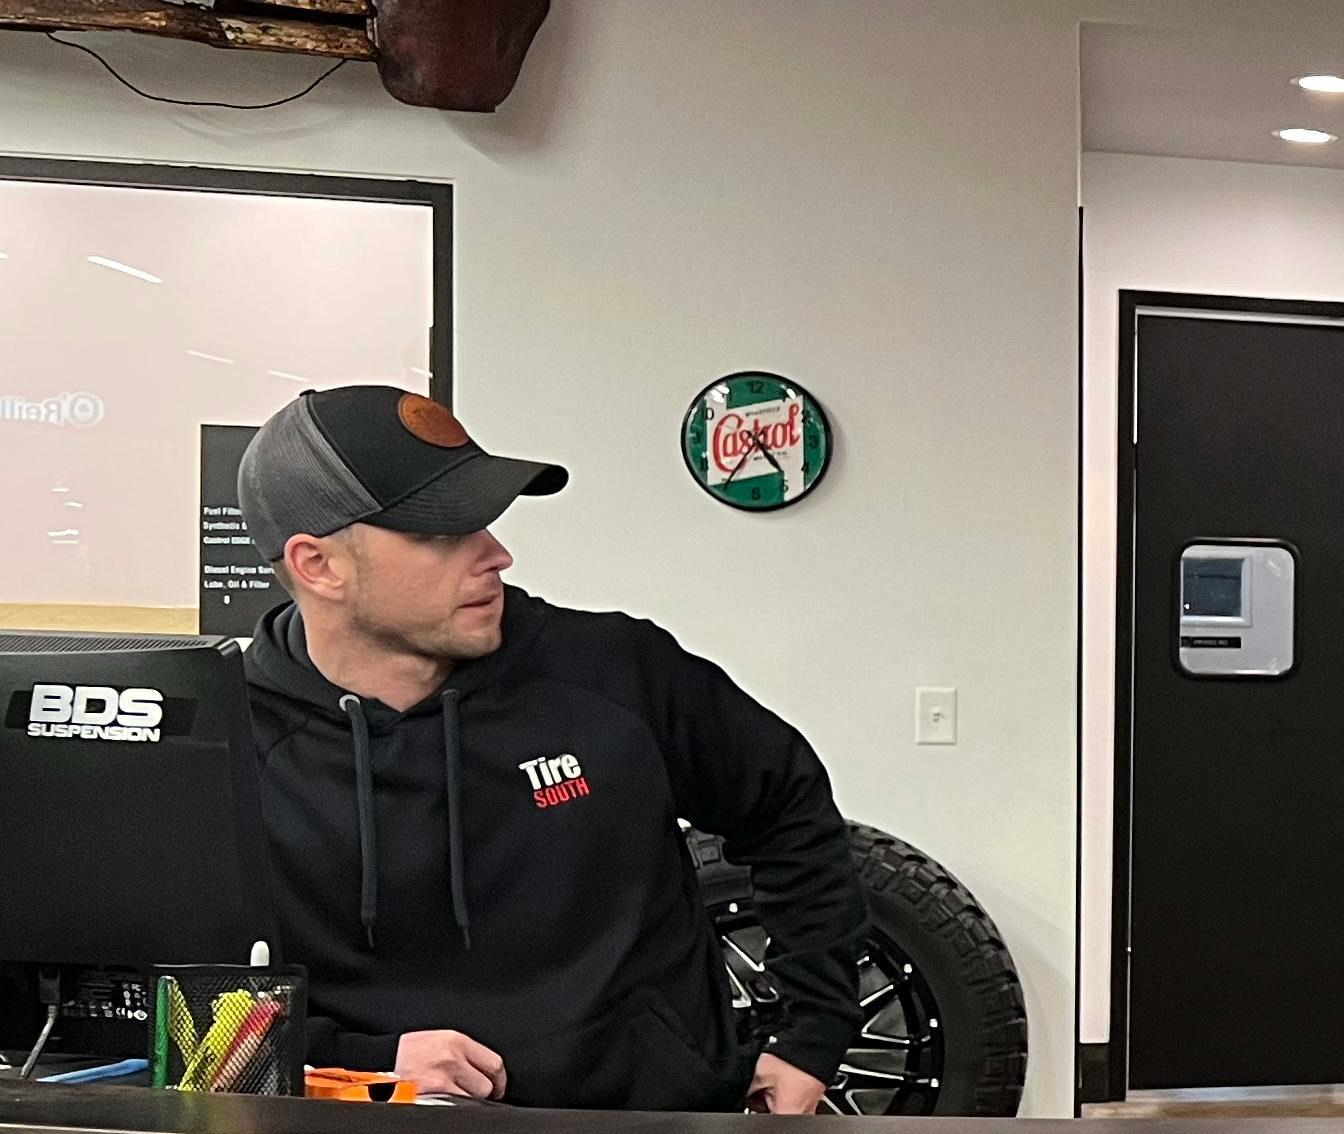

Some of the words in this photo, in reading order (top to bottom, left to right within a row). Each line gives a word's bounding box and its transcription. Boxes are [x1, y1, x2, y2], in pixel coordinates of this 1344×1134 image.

[712, 403, 800, 473] Castrol
[29, 684, 164, 728] BDS
[27, 723, 161, 742] SUSPENSION
[518, 753, 582, 791] Tire
[533, 777, 591, 809] SOUTH
